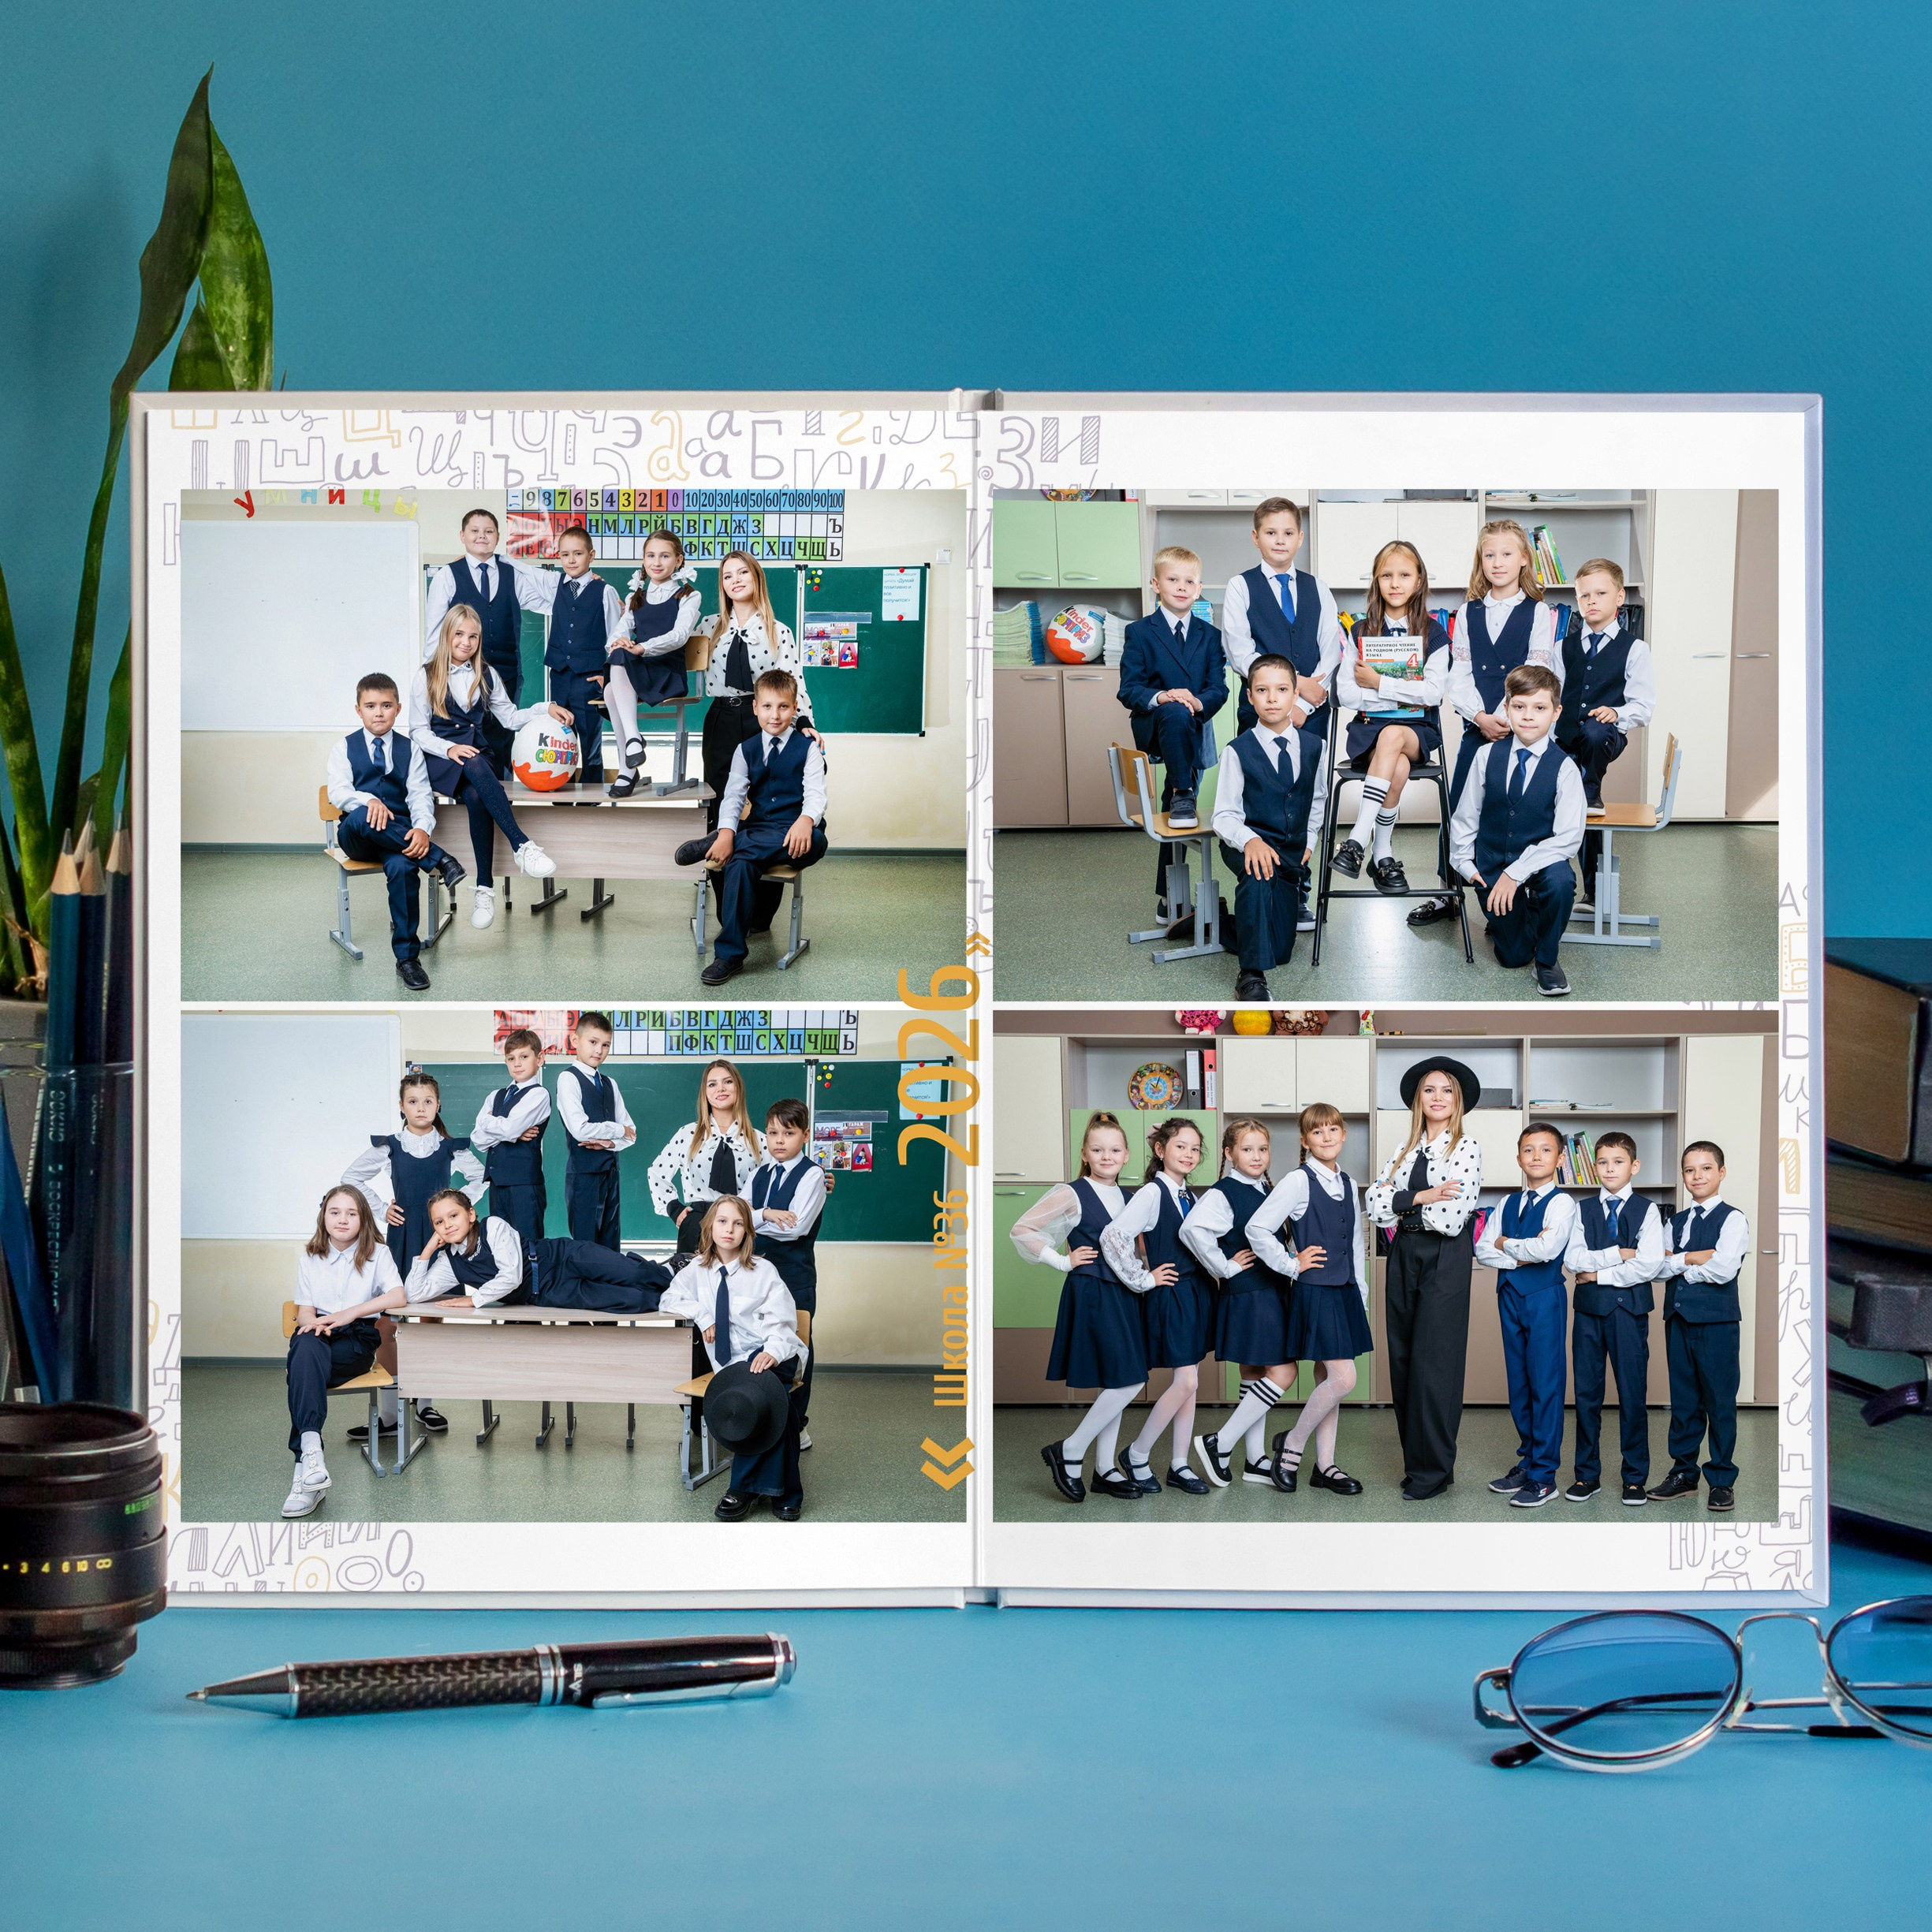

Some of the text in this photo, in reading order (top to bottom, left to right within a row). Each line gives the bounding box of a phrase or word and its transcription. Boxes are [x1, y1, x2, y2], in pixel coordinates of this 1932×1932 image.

[526, 491, 843, 507] 9 8 7 6 5 4 3 2 1 0 10 20 30 40 50 60 70 80 90 100
[588, 519, 600, 534] Н
[603, 519, 617, 534] М
[621, 519, 633, 534] Л
[639, 519, 649, 534] Р
[671, 519, 681, 534] Б
[686, 519, 697, 534] В
[703, 519, 712, 534] Г
[717, 519, 729, 536] Д
[733, 519, 746, 534] Ж
[752, 519, 761, 534] З
[829, 519, 842, 534] Ъ
[684, 542, 698, 556] Ф
[701, 542, 712, 556] К
[717, 542, 729, 556] Т
[751, 542, 760, 556] С
[766, 542, 777, 556] Х
[781, 542, 793, 558] Ц
[797, 542, 808, 556] Ч
[811, 542, 826, 558] Щ
[830, 543, 841, 557] Ь
[1407, 653, 1419, 668] 4
[616, 1011, 629, 1027] Л
[636, 1011, 647, 1027] Р
[669, 1011, 681, 1027] Б
[687, 1011, 698, 1027] В
[704, 1011, 714, 1027] Г
[720, 1011, 733, 1029] Д
[737, 1011, 752, 1027] Ж
[758, 1011, 768, 1027] З
[842, 1010, 856, 1025] Ъ
[684, 1035, 699, 1050] Ф
[703, 1035, 715, 1050] К
[720, 1035, 733, 1050] Т
[737, 1035, 751, 1050] Ш
[756, 1034, 766, 1050] С
[773, 1035, 785, 1050] Х
[789, 1035, 802, 1053] Ц
[807, 1034, 819, 1050] Ч
[822, 1034, 838, 1053] Щ
[843, 1034, 854, 1050] Ь
[897, 965, 979, 1166] 2026
[934, 1189, 968, 1269] №36
[934, 1286, 968, 1406] Школа
[21, 1561, 28, 1573] 3
[41, 1562, 50, 1573] 4
